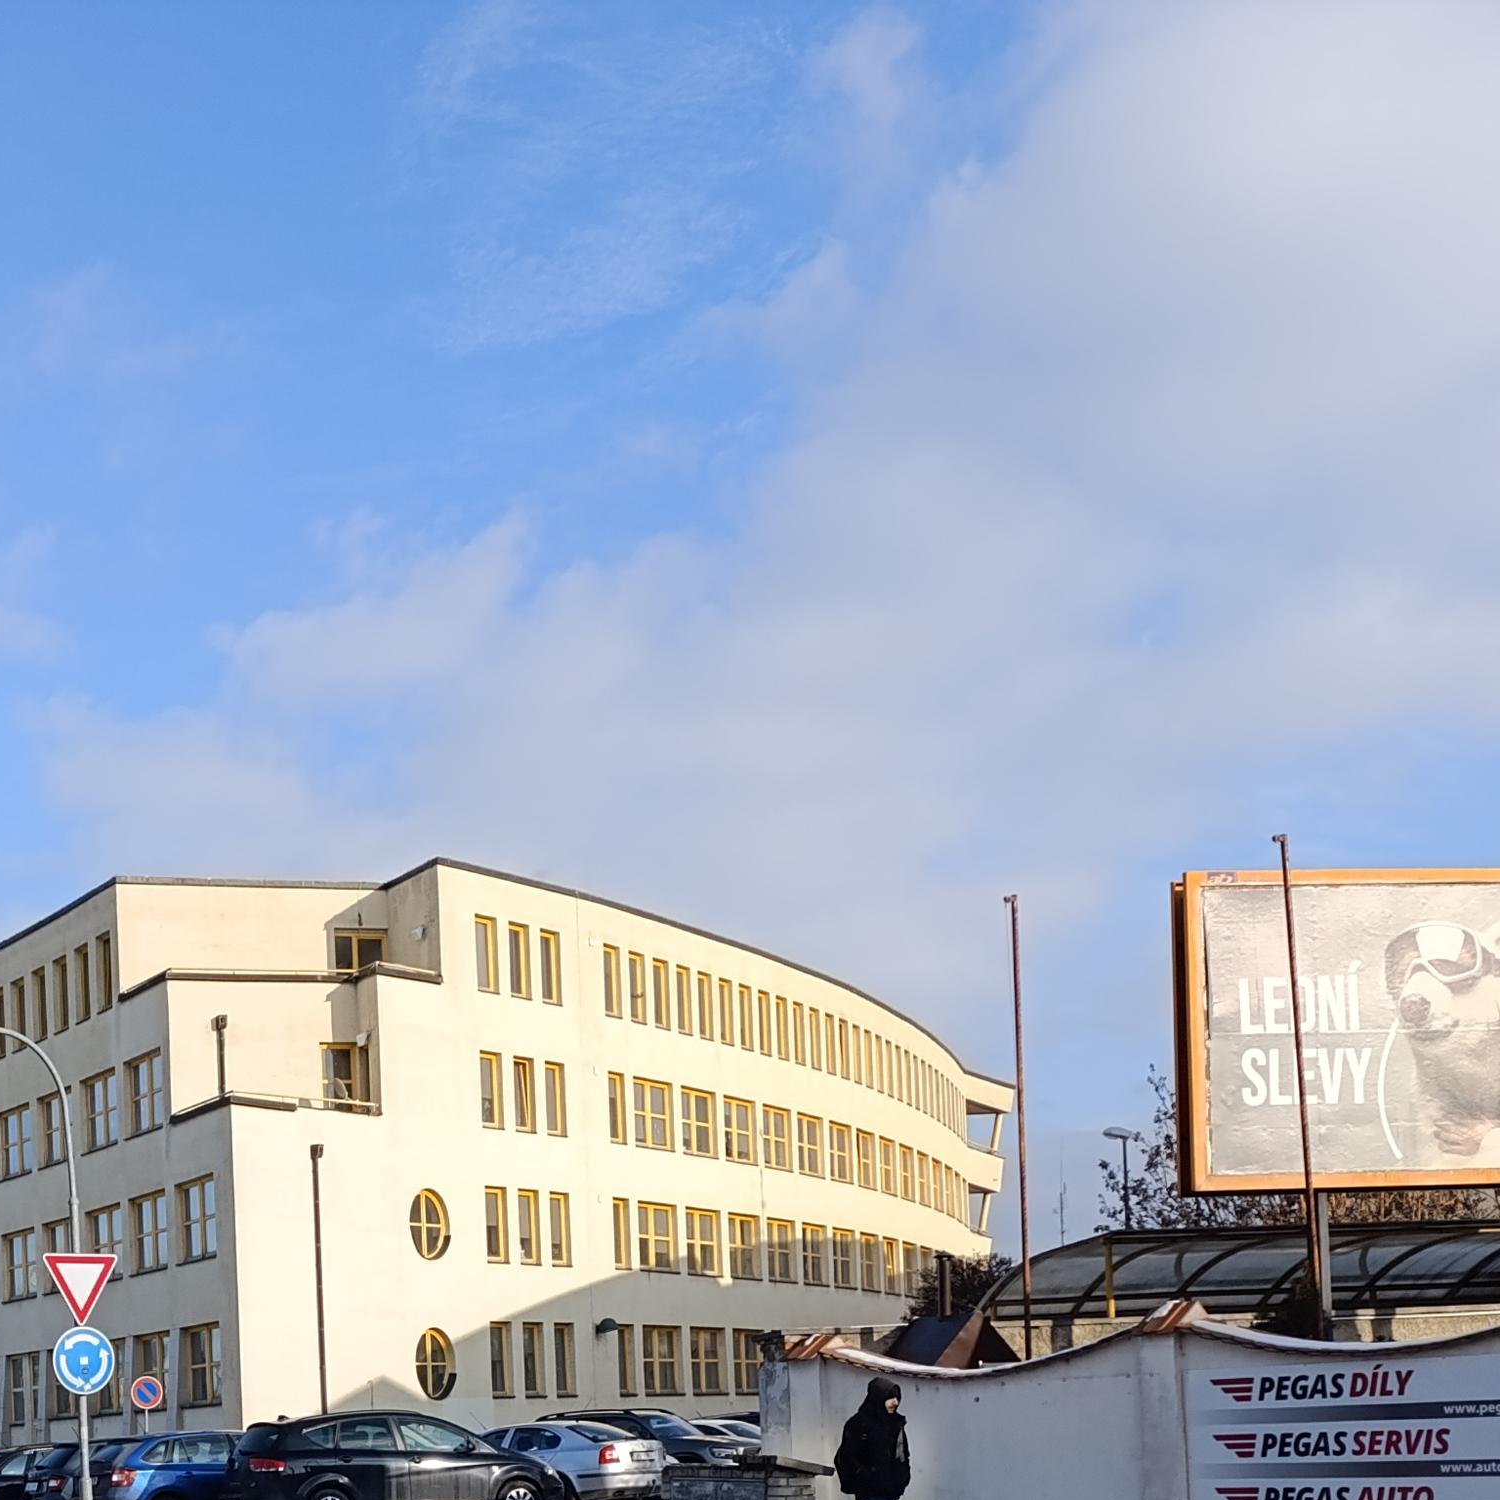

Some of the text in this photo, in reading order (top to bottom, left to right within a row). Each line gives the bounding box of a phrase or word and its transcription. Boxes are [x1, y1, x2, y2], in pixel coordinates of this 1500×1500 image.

[1238, 960, 1363, 1034] LEDNÍ
[1241, 1048, 1372, 1106] SLEVY
[1258, 1364, 1414, 1401] PEGAS DÍLY
[1261, 1428, 1451, 1457] PEGAS SERVIS
